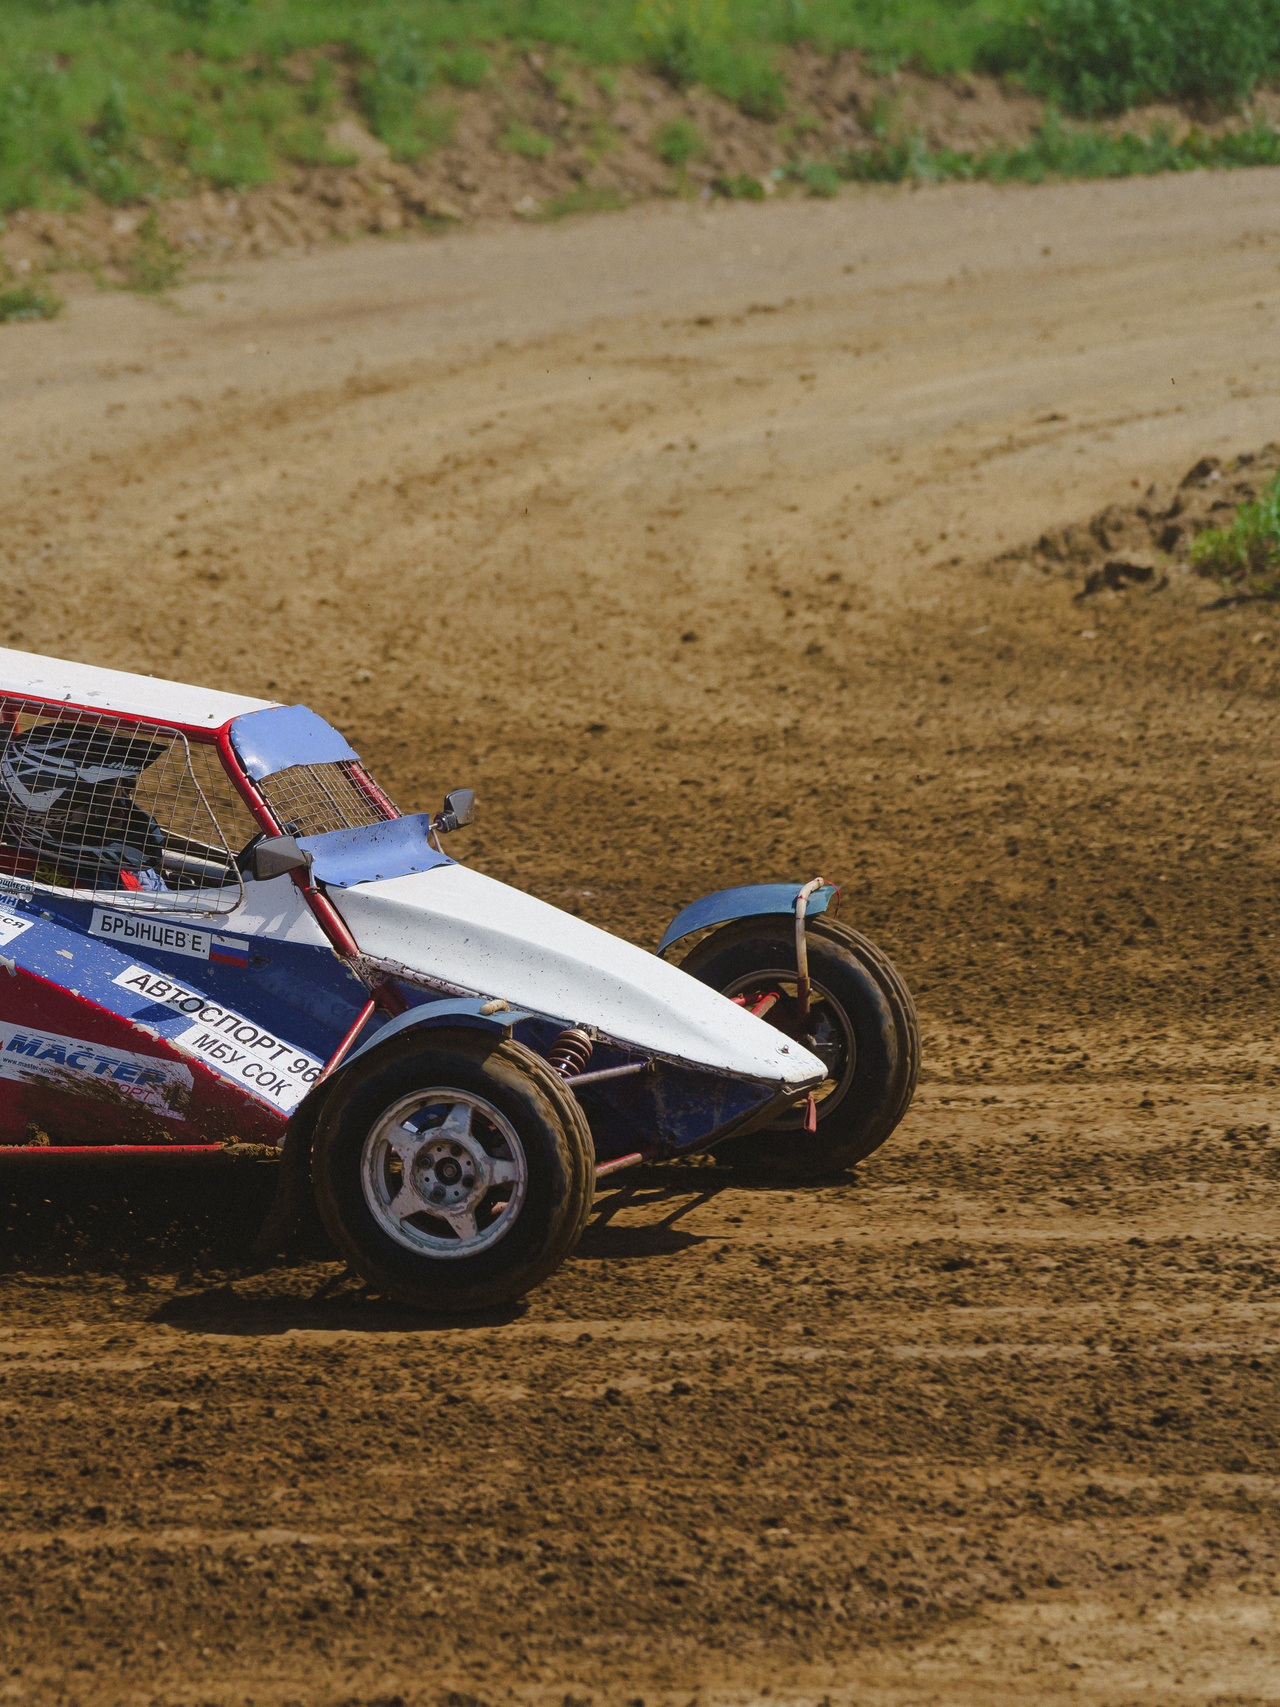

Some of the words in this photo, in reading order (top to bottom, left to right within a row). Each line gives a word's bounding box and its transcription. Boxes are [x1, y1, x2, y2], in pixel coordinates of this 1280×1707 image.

[100, 914, 187, 949] БРЫНЦЕВ
[191, 935, 206, 954] Е.
[125, 974, 294, 1062] АВТОСПОРТ
[287, 1058, 322, 1084] 96
[5, 1034, 168, 1086] МАСТЕР
[192, 1032, 246, 1065] МБУ
[241, 1062, 293, 1097] СОК
